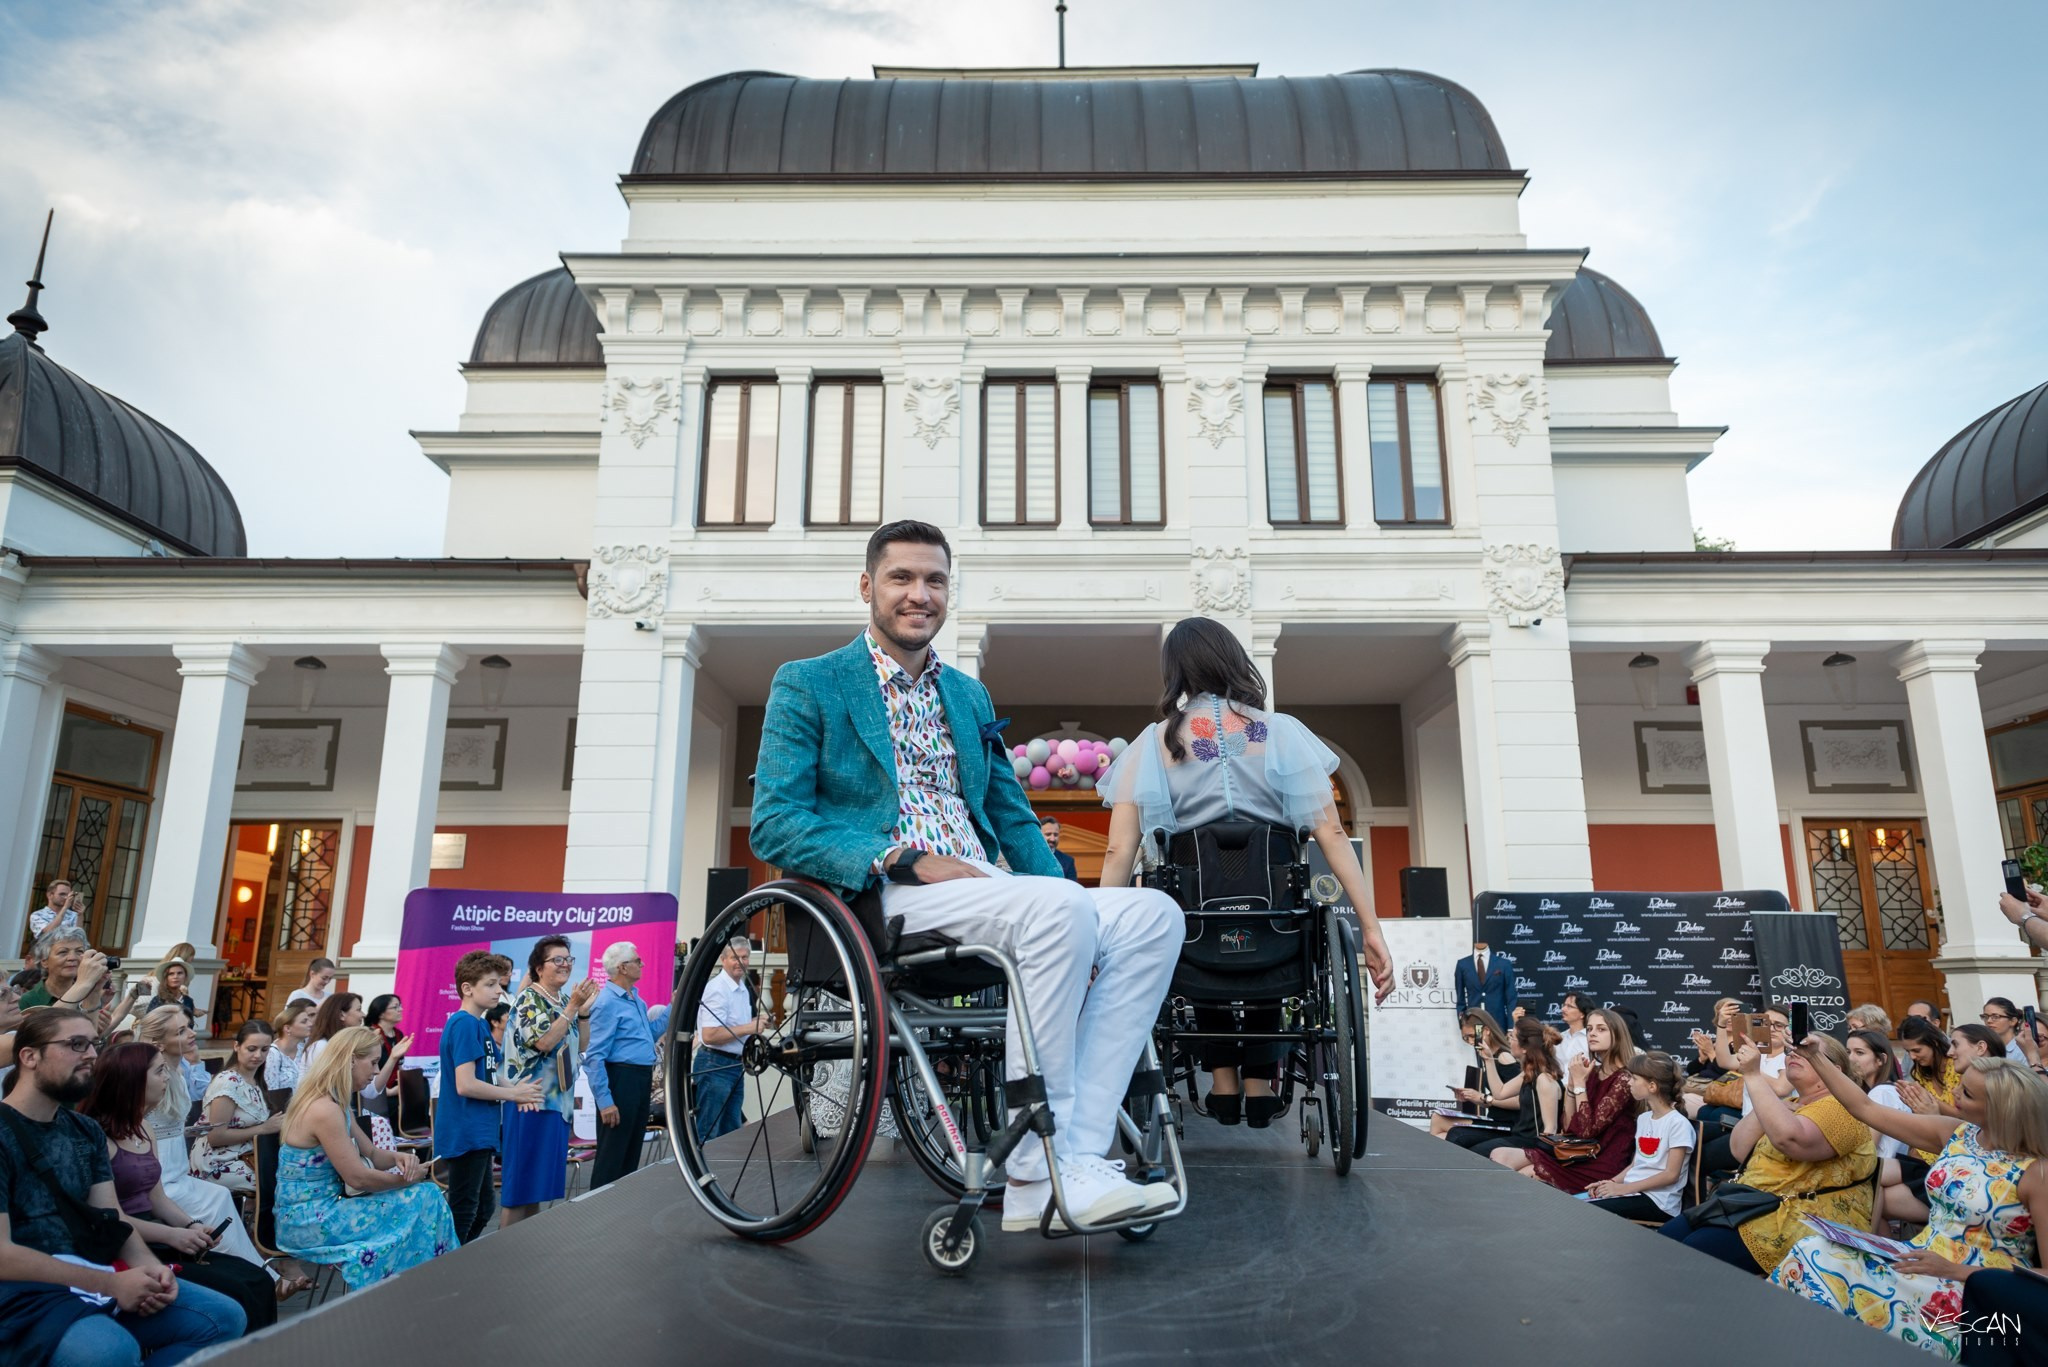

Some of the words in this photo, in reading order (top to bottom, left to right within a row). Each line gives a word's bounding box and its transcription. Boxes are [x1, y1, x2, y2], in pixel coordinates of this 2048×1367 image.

[452, 905, 501, 925] Atipic
[503, 906, 563, 927] Beauty
[565, 907, 596, 927] Cluj
[597, 906, 633, 923] 2019
[1386, 991, 1422, 1004] EN's
[1429, 990, 1457, 1004] CLU
[1424, 1100, 1457, 1108] Ferdinand
[936, 1104, 966, 1153] panthera
